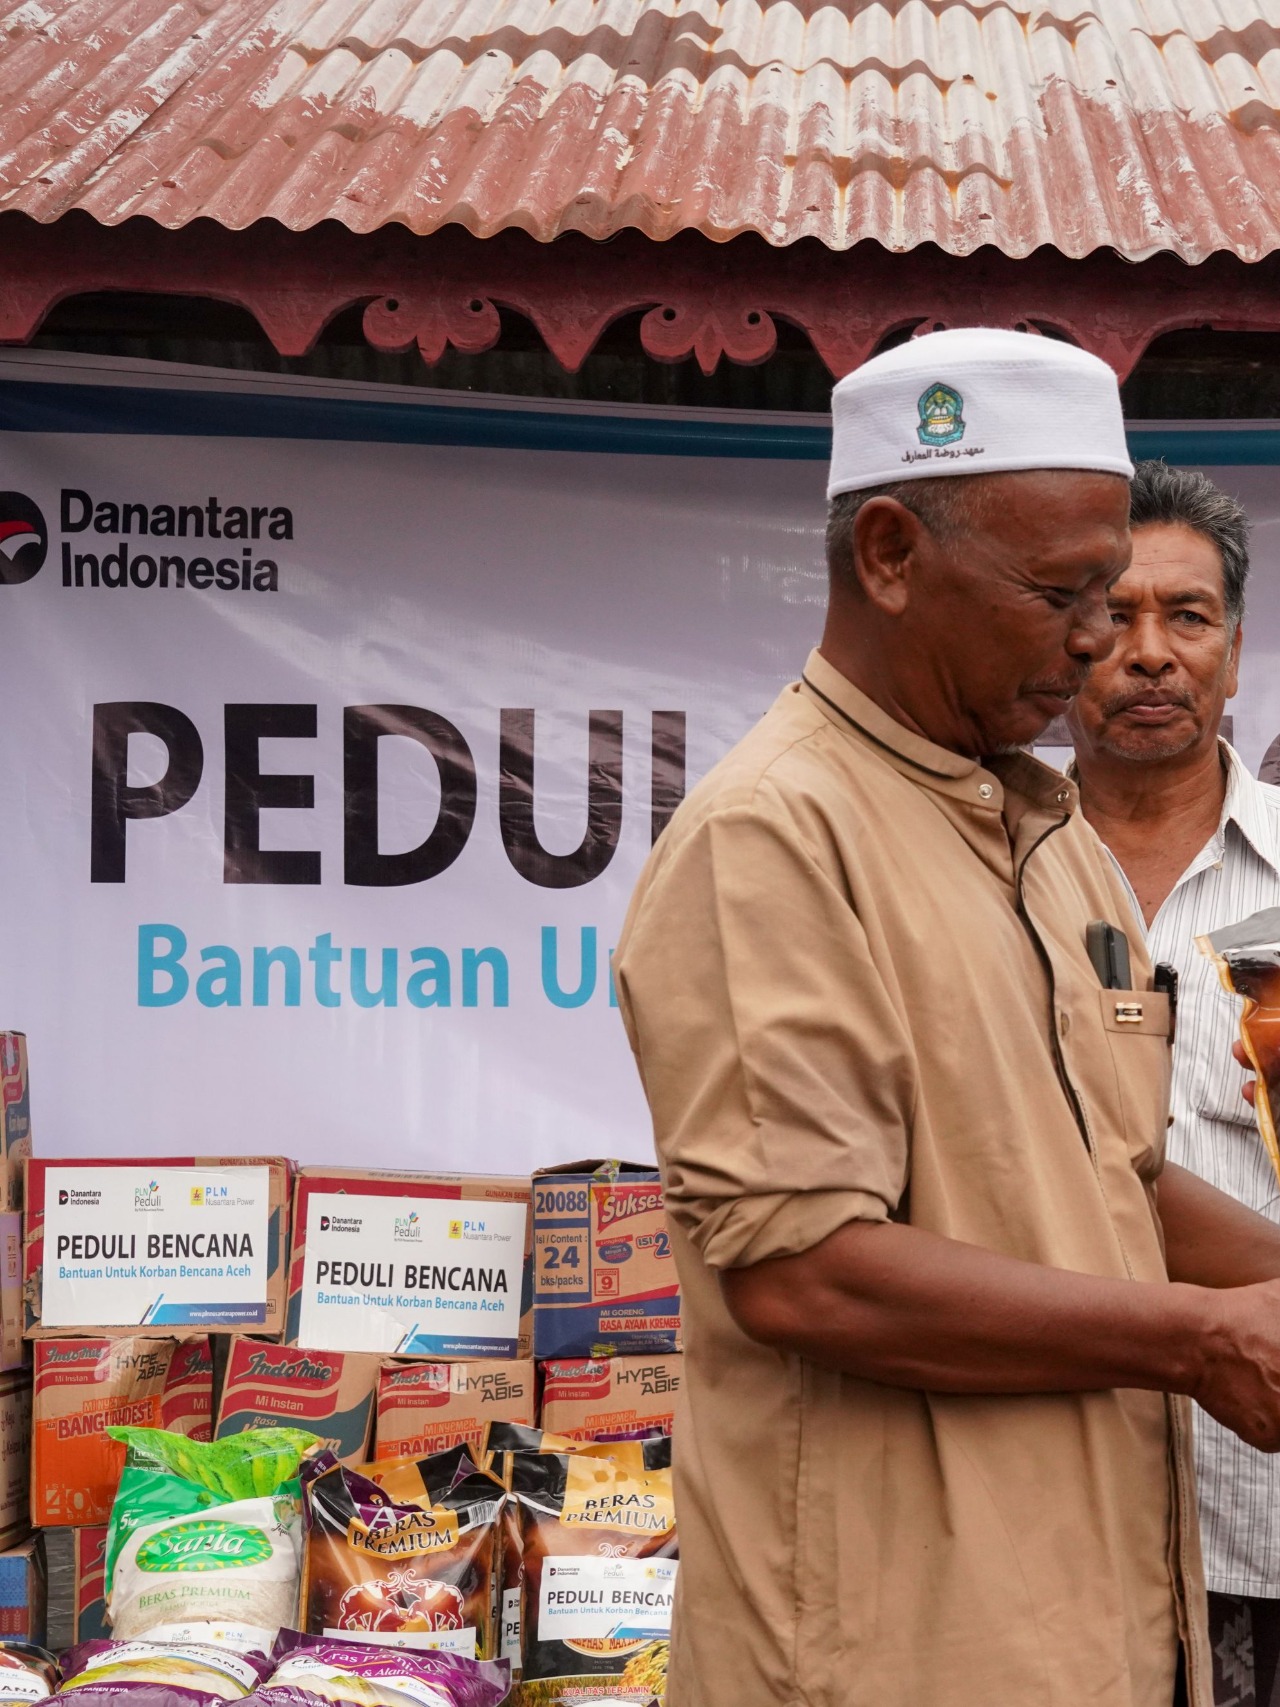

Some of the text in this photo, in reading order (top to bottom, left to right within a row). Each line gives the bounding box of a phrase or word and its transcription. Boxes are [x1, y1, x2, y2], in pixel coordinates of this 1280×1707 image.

[60, 488, 294, 541] Danantara
[61, 542, 279, 592] Indonesia
[137, 923, 509, 1008] Bantuan
[70, 1189, 101, 1198] Danantara
[135, 1187, 149, 1197] PLN
[205, 1187, 228, 1197] PLN
[70, 1198, 100, 1206] Indonesia
[134, 1196, 161, 1207] Peduli
[205, 1198, 255, 1206] Nusantara Power
[536, 1191, 587, 1213] 20088
[332, 1216, 363, 1226] Danantara
[395, 1217, 409, 1227] PLN
[464, 1221, 485, 1232] PLN
[331, 1225, 360, 1233] Indonesia
[394, 1226, 420, 1238] Peduli
[463, 1232, 512, 1242] Nusantara Power
[638, 1233, 671, 1256] ISI 2
[57, 1233, 254, 1260] PEDULI BENCANA
[543, 1246, 580, 1269] 24
[59, 1264, 251, 1279] Bantuan Untuk Korban Bencana Aceh
[316, 1260, 508, 1293] PEDULI BENCANA
[540, 1275, 583, 1290] bks/packs
[601, 1276, 613, 1290] 9
[317, 1292, 505, 1312] Bantuan Untuk Korban Bencana Aceh
[612, 1308, 644, 1317] GORENG
[600, 1319, 622, 1331] RASA
[624, 1318, 647, 1330] AYAM
[116, 1354, 159, 1371] HYPE
[234, 1350, 333, 1381] Indomie
[65, 1374, 89, 1382] Instan
[136, 1364, 168, 1382] ABIS
[617, 1366, 670, 1385] HYPE
[457, 1372, 509, 1391] HYPE
[641, 1377, 680, 1396] ABIS
[480, 1384, 524, 1403] ABIS
[567, 1390, 590, 1398] Instan
[193, 1398, 208, 1409] Mi
[255, 1395, 304, 1411] Mi Instan
[405, 1398, 430, 1406] Instan
[253, 1416, 278, 1427] Rasa
[585, 1494, 656, 1510] BERAS
[368, 1511, 436, 1541] BERAS
[565, 1511, 668, 1530] PREMIUM
[159, 1529, 245, 1556] Sania
[353, 1529, 453, 1554] PREMIUM
[657, 1568, 671, 1576] PLN
[139, 1586, 251, 1608] BERAS PREMIUM
[547, 1590, 674, 1606] PEDULI BENCAN
[580, 1606, 603, 1614] Untuk
[605, 1607, 633, 1616] Korban
[635, 1608, 668, 1616] Bencana
[440, 1641, 456, 1649] PLN
[563, 1685, 650, 1697] KUALITAS TERJAMIN
